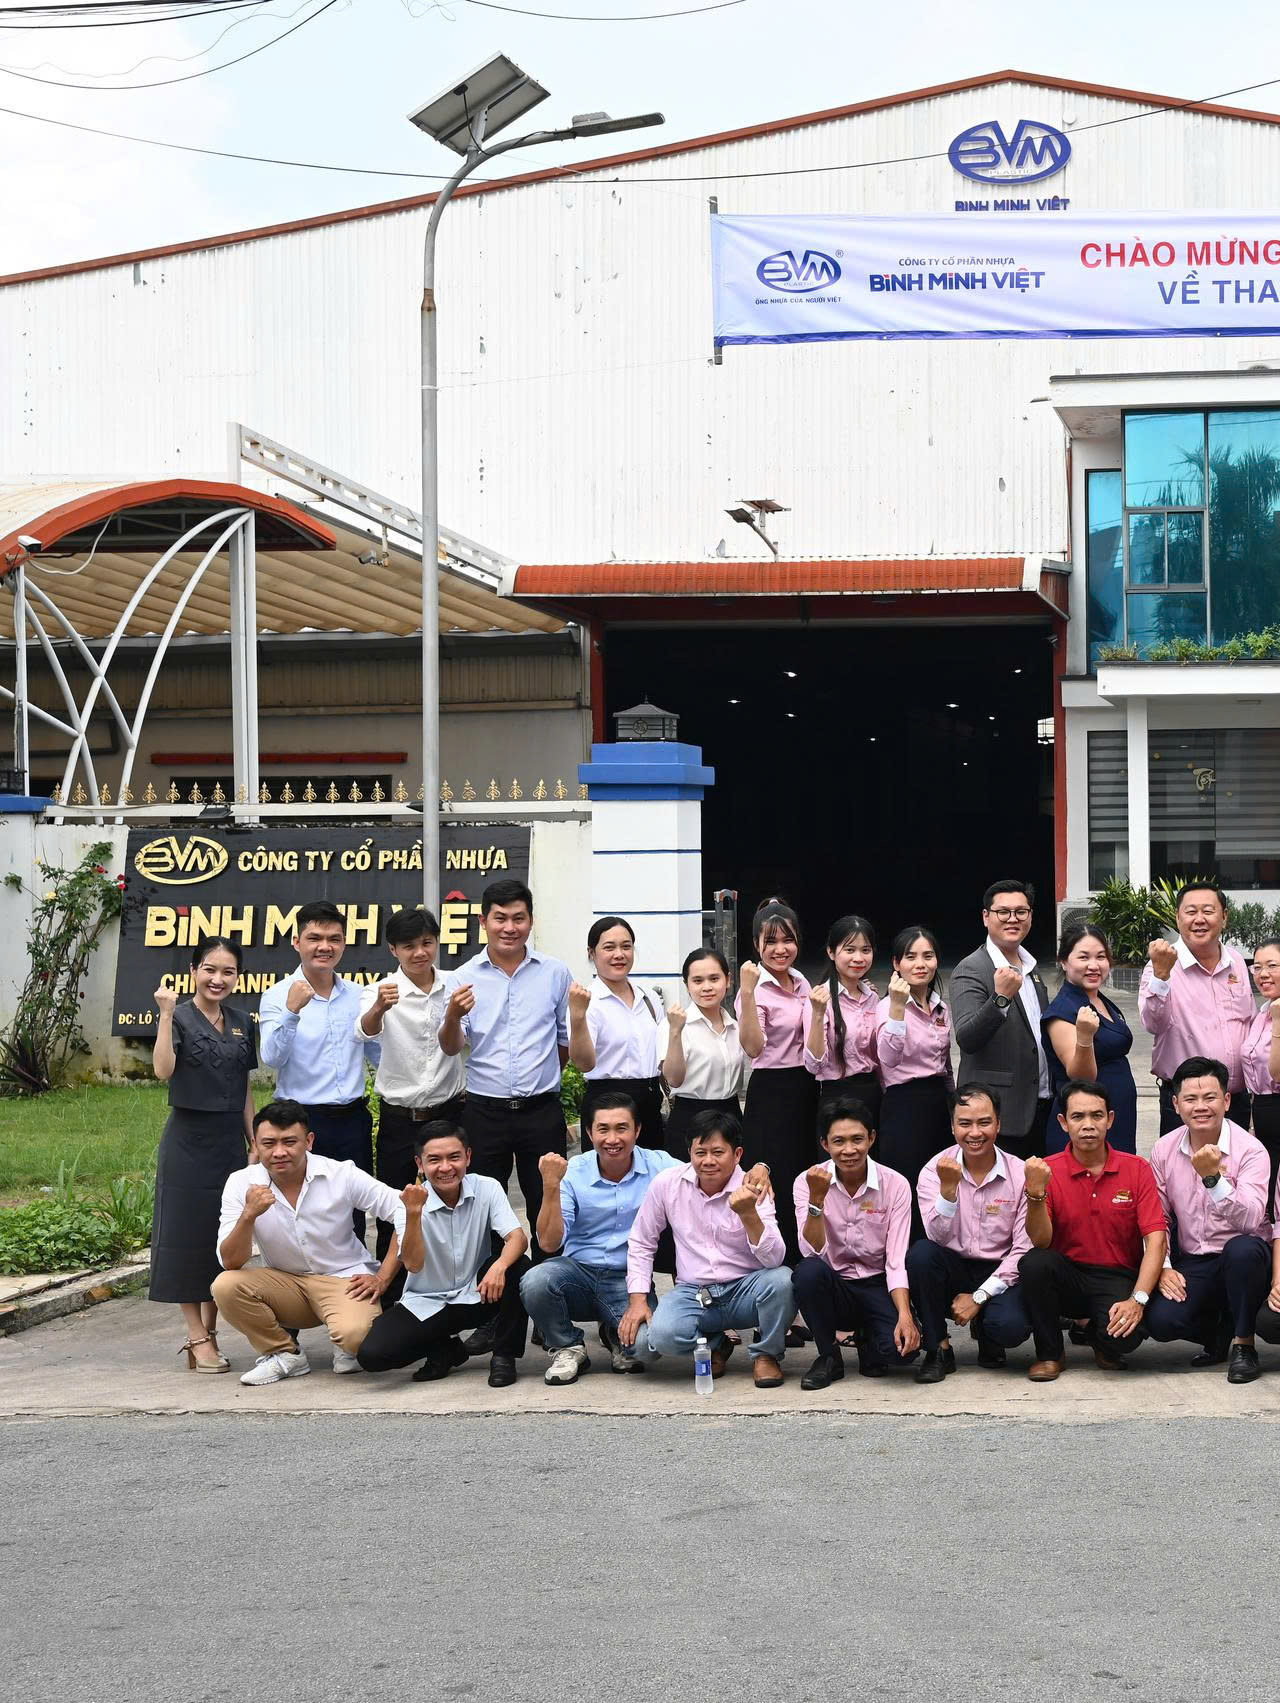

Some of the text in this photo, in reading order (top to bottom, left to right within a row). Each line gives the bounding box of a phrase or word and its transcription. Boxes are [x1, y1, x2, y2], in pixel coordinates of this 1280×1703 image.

[898, 256, 926, 266] CÔNG
[929, 258, 939, 266] TY
[986, 257, 1015, 268] NHỰA
[1081, 236, 1176, 268] CHÀO
[991, 267, 1046, 293] VIỆT
[1157, 270, 1200, 305] VỀ
[237, 838, 508, 876] CÔNG TY CỔ PHẦ NHỰA
[263, 903, 379, 947] MH
[138, 1010, 153, 1025] LÔ
